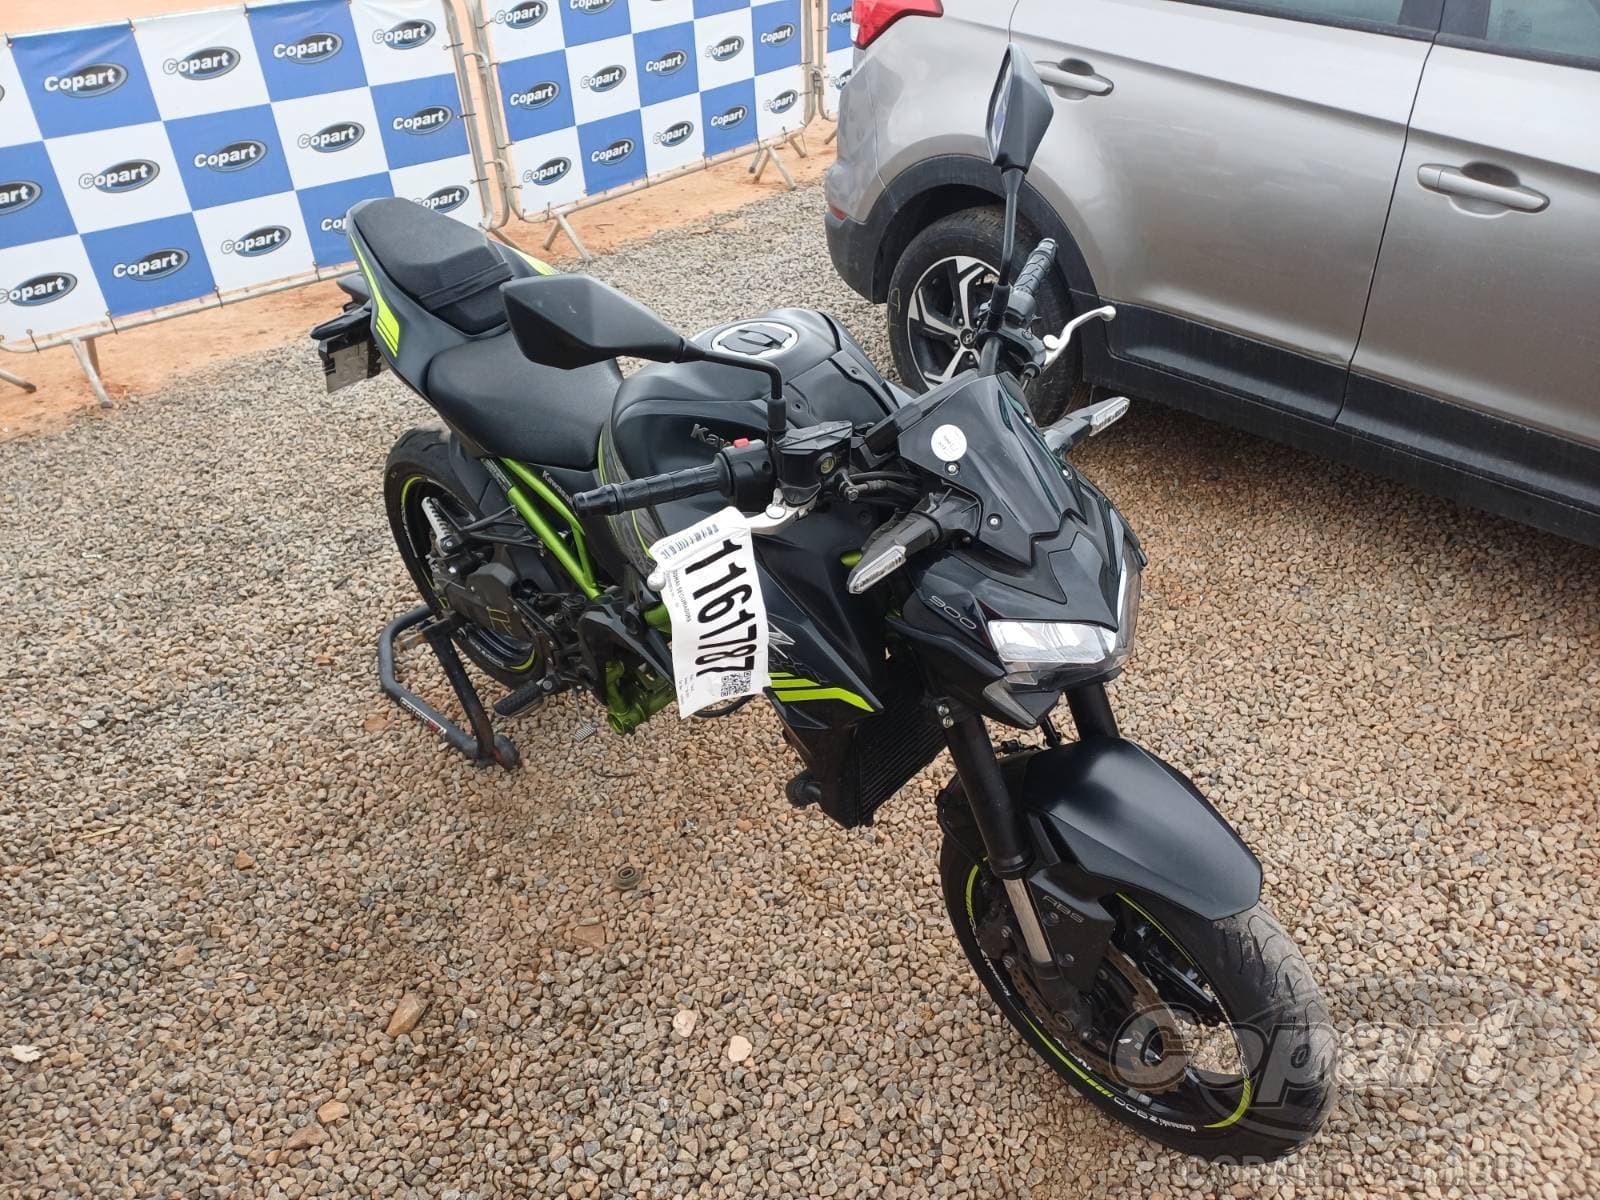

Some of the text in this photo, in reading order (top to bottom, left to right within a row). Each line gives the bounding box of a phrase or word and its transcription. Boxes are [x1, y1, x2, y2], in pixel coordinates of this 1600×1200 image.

[495, 5, 541, 24] Copart
[372, 24, 427, 44] Copart
[760, 26, 792, 44] Copart
[273, 37, 333, 59] Copart
[704, 40, 739, 58] Copart
[163, 52, 230, 75] Copart
[645, 53, 683, 73] Copart
[43, 68, 116, 92] Copart
[580, 69, 620, 89] Copart
[509, 86, 553, 106] Copart
[763, 93, 794, 111] Copart
[392, 110, 445, 131] Copart
[710, 109, 744, 127] Copart
[297, 126, 355, 149] Copart
[653, 125, 689, 145] Copart
[193, 144, 257, 168] Copart
[591, 142, 630, 163] Copart
[79, 164, 148, 189] Copart
[523, 162, 565, 183] Copart
[0, 186, 28, 204] art
[221, 230, 282, 254] Copart
[112, 252, 179, 278] Copart
[684, 538, 758, 677] 1161787
[929, 595, 977, 630] 900
